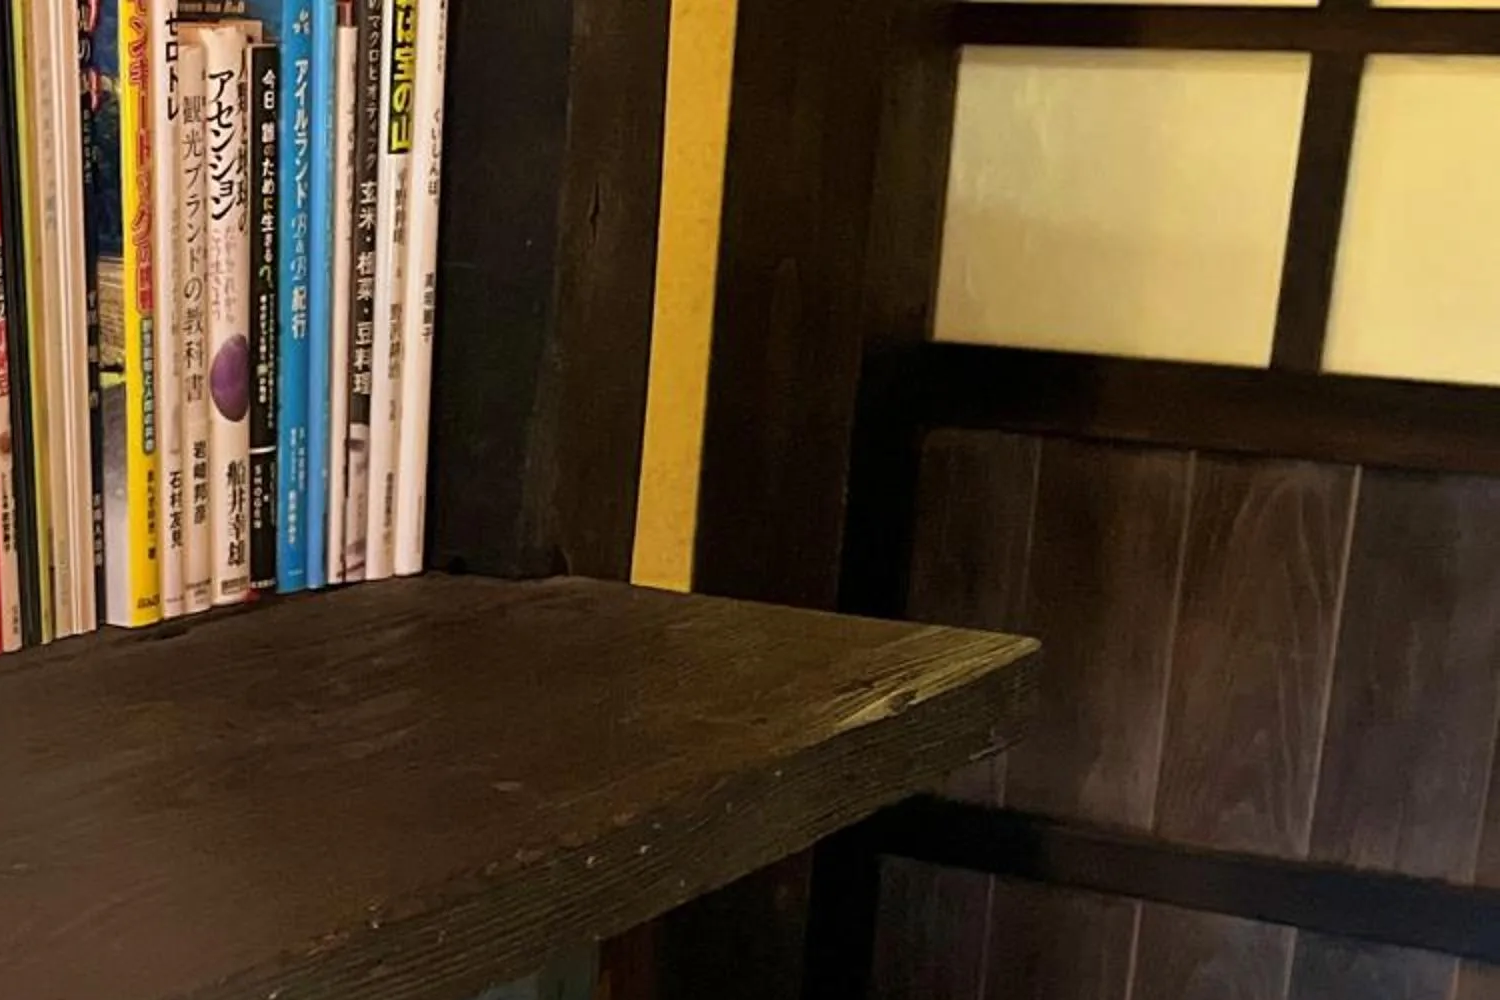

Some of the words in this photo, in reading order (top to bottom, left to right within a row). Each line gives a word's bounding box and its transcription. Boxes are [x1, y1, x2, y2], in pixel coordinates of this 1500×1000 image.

[206, 70, 235, 221] アセンション
